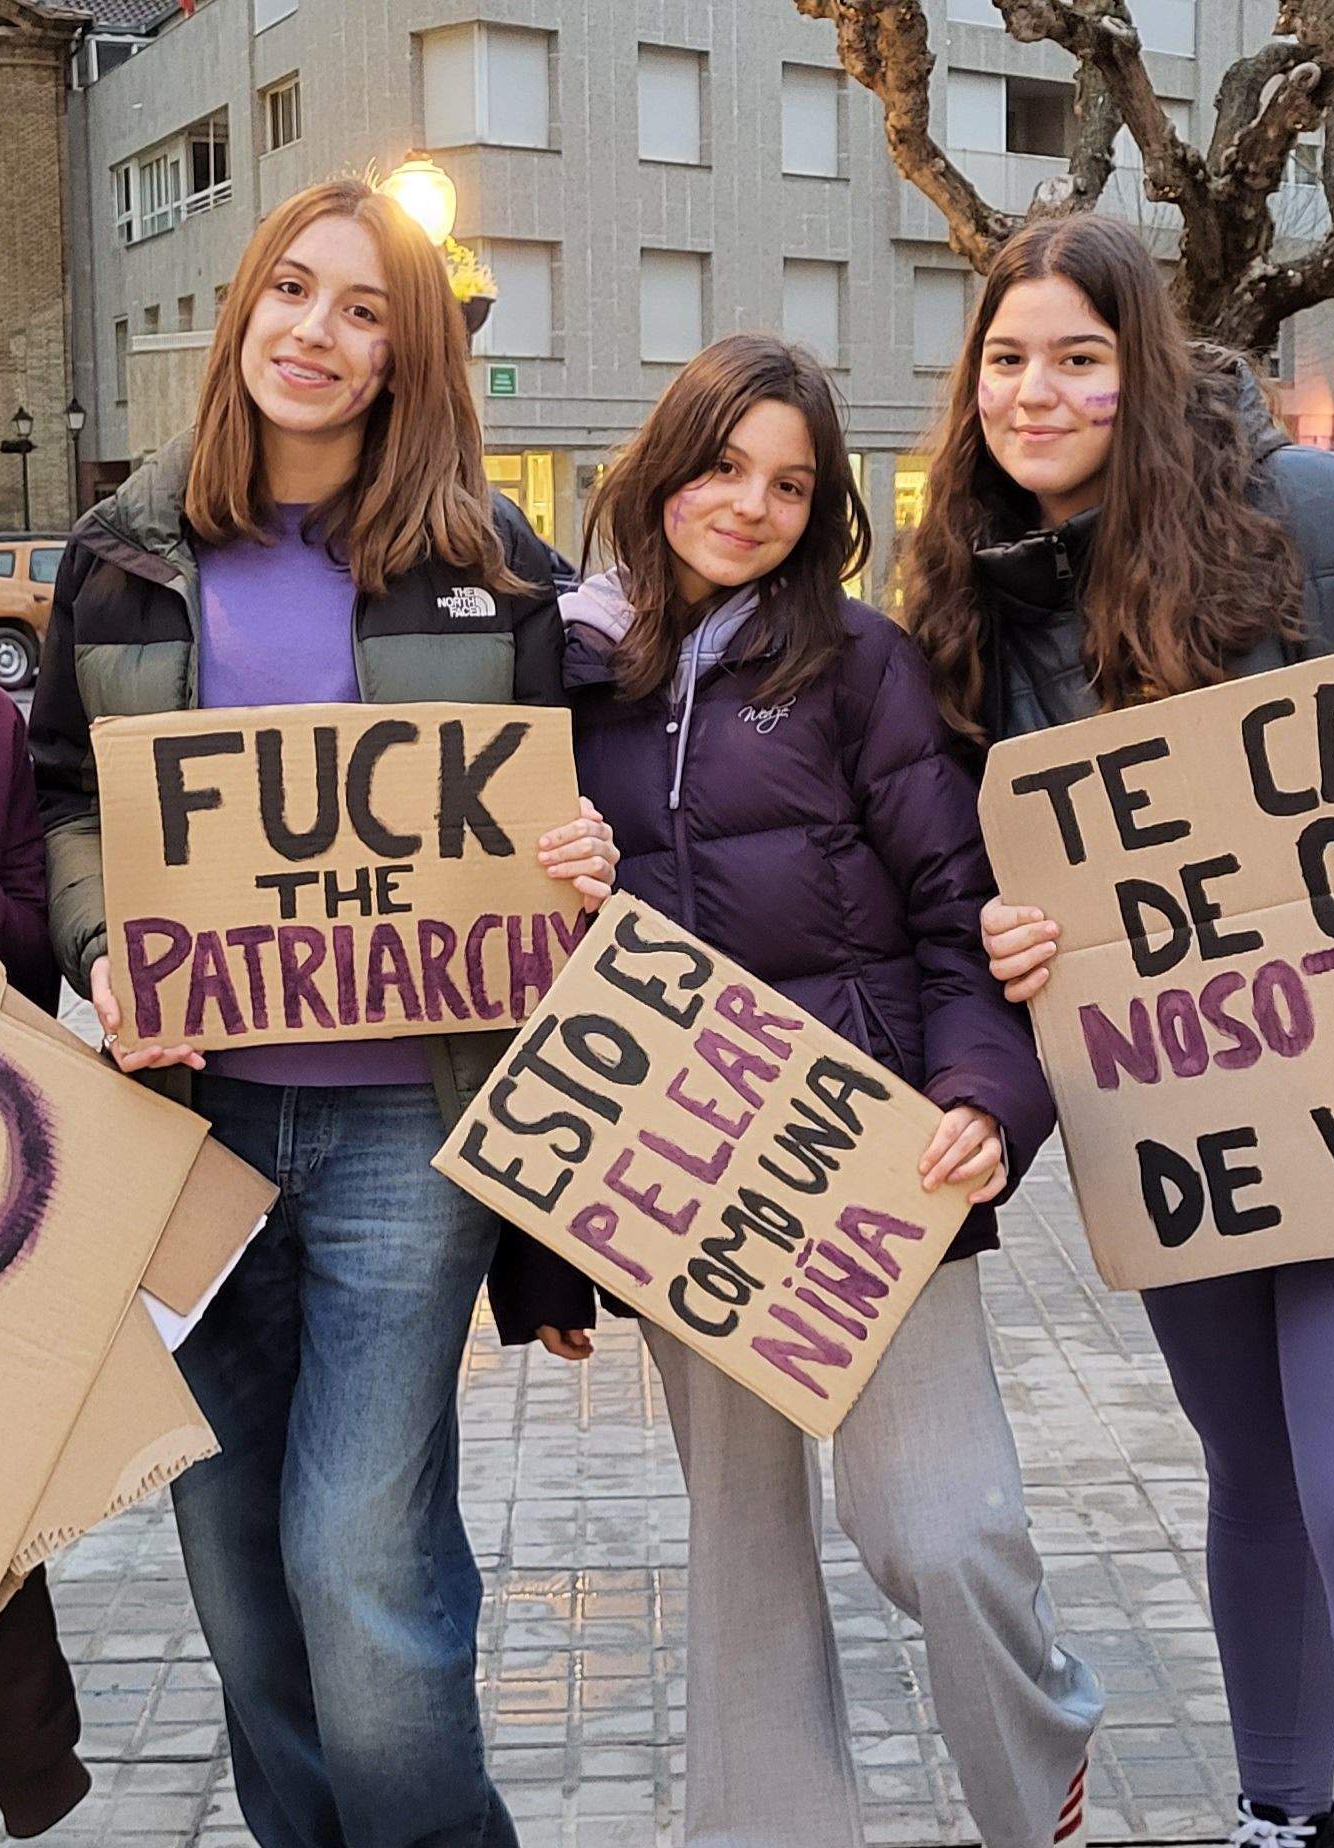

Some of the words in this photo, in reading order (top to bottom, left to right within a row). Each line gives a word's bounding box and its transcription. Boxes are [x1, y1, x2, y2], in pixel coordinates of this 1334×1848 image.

[436, 596, 476, 608] NORTH
[448, 606, 477, 618] FACE
[450, 586, 475, 597] THE
[152, 719, 533, 867] FUCK
[1011, 737, 1192, 865] TE
[254, 864, 415, 919] THE
[1114, 852, 1265, 978] DE
[459, 1013, 651, 1214] ESTO
[593, 910, 715, 1030] ES
[567, 983, 805, 1287] PELEAR
[667, 1185, 806, 1338] COMO
[757, 1055, 892, 1195] UNA
[1135, 1125, 1282, 1248] DE
